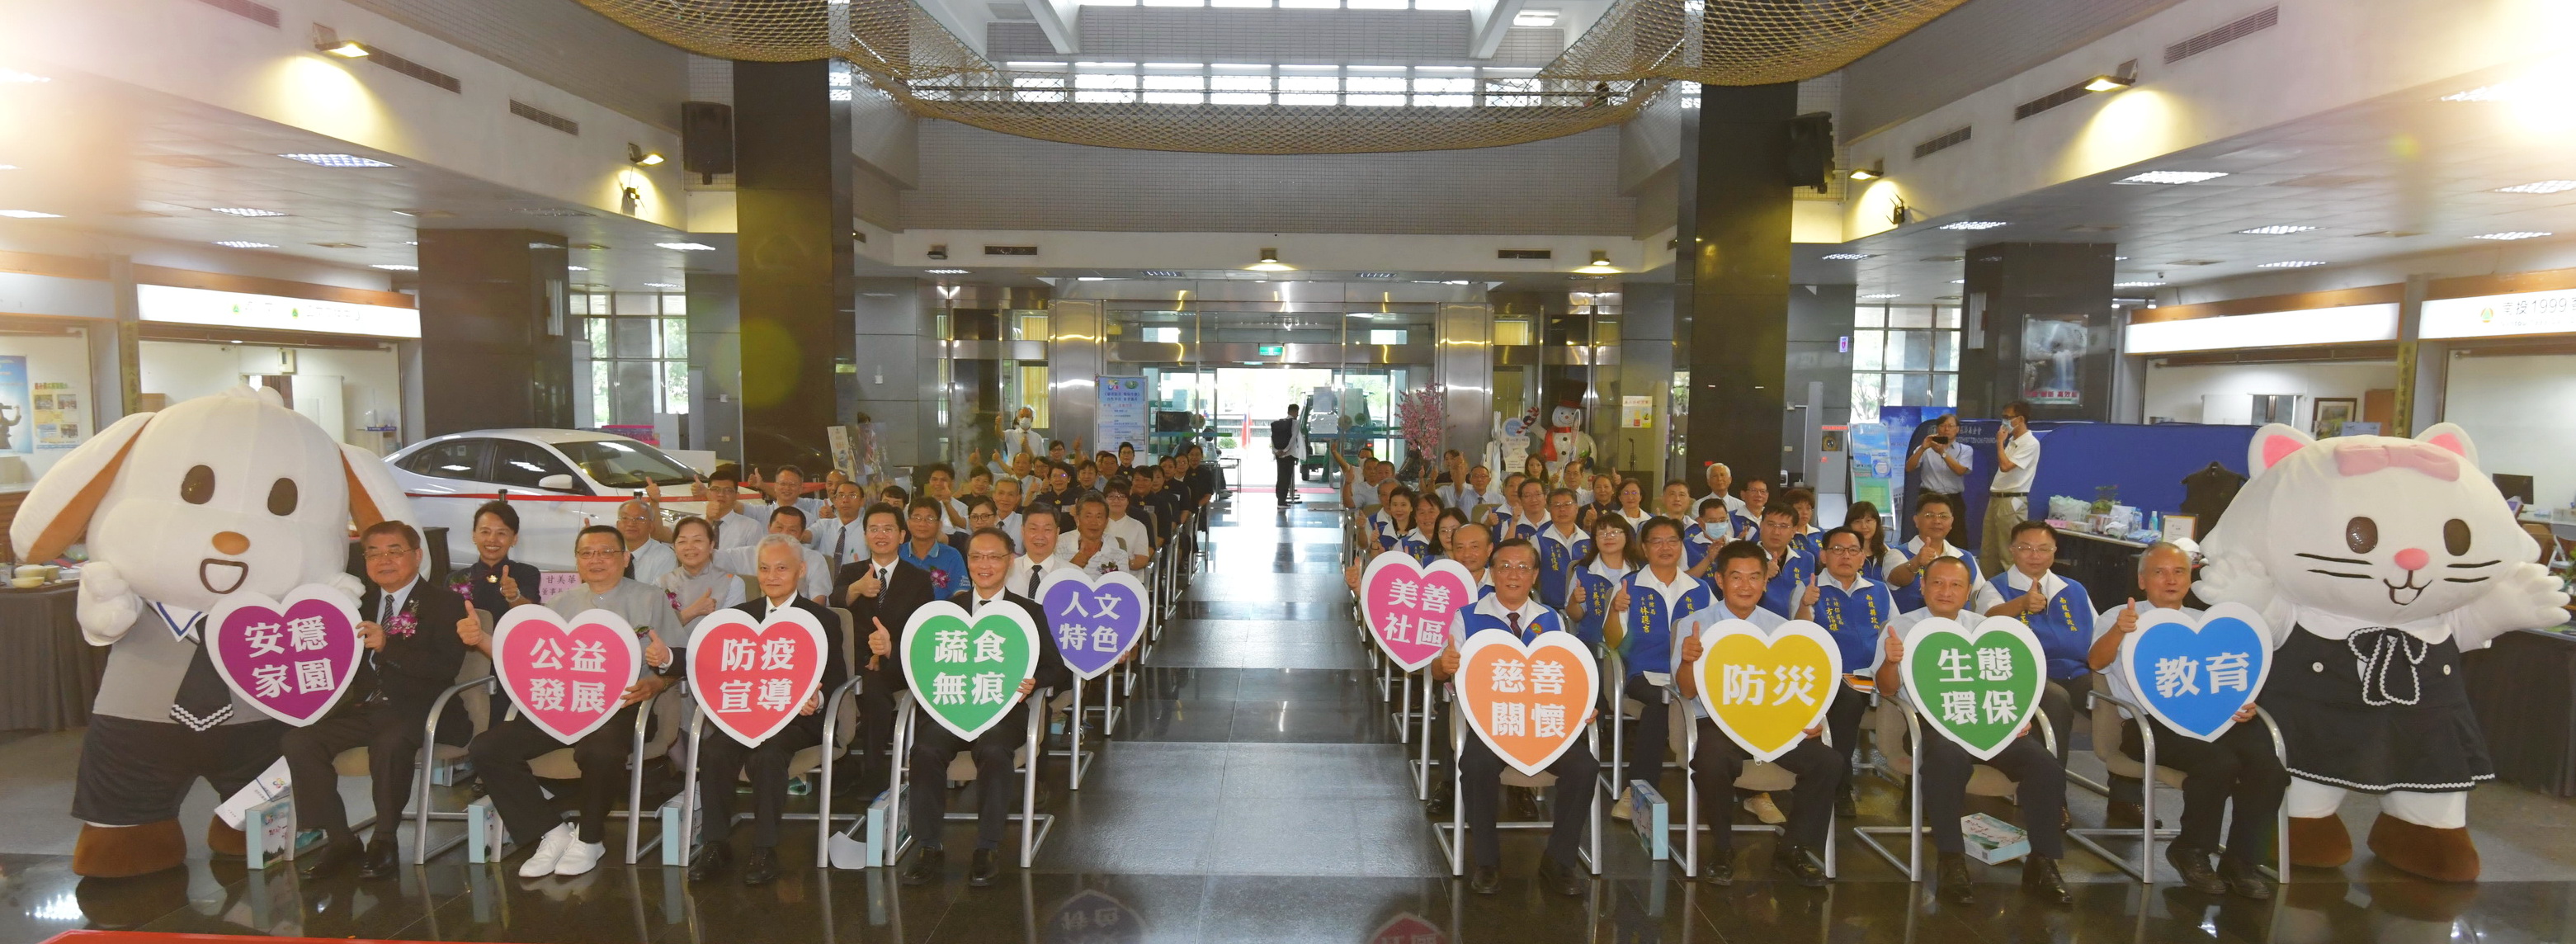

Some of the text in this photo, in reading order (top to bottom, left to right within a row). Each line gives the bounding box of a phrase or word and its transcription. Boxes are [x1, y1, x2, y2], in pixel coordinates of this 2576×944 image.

[2503, 297, 2576, 315] 南投1999
[546, 575, 576, 584] 甘美華
[1388, 578, 1451, 614] 美善
[1061, 591, 1122, 620] 人文
[244, 615, 328, 658] 安穩
[933, 629, 1007, 663] 蔬食
[1059, 622, 1119, 653] 特色
[1384, 611, 1446, 648] 社區
[529, 637, 607, 673] 公益
[720, 637, 796, 672] 防疫
[1937, 647, 2013, 682] 生態
[252, 658, 335, 698] 家園
[932, 671, 1006, 706] 無痕
[1491, 658, 1566, 695] 慈善
[1722, 663, 1816, 707] 防災
[2154, 651, 2250, 699] 教育
[529, 677, 606, 715] 發展
[717, 677, 794, 714] 宣導
[1940, 689, 2018, 725] 環保
[1491, 701, 1566, 739] 關懷
